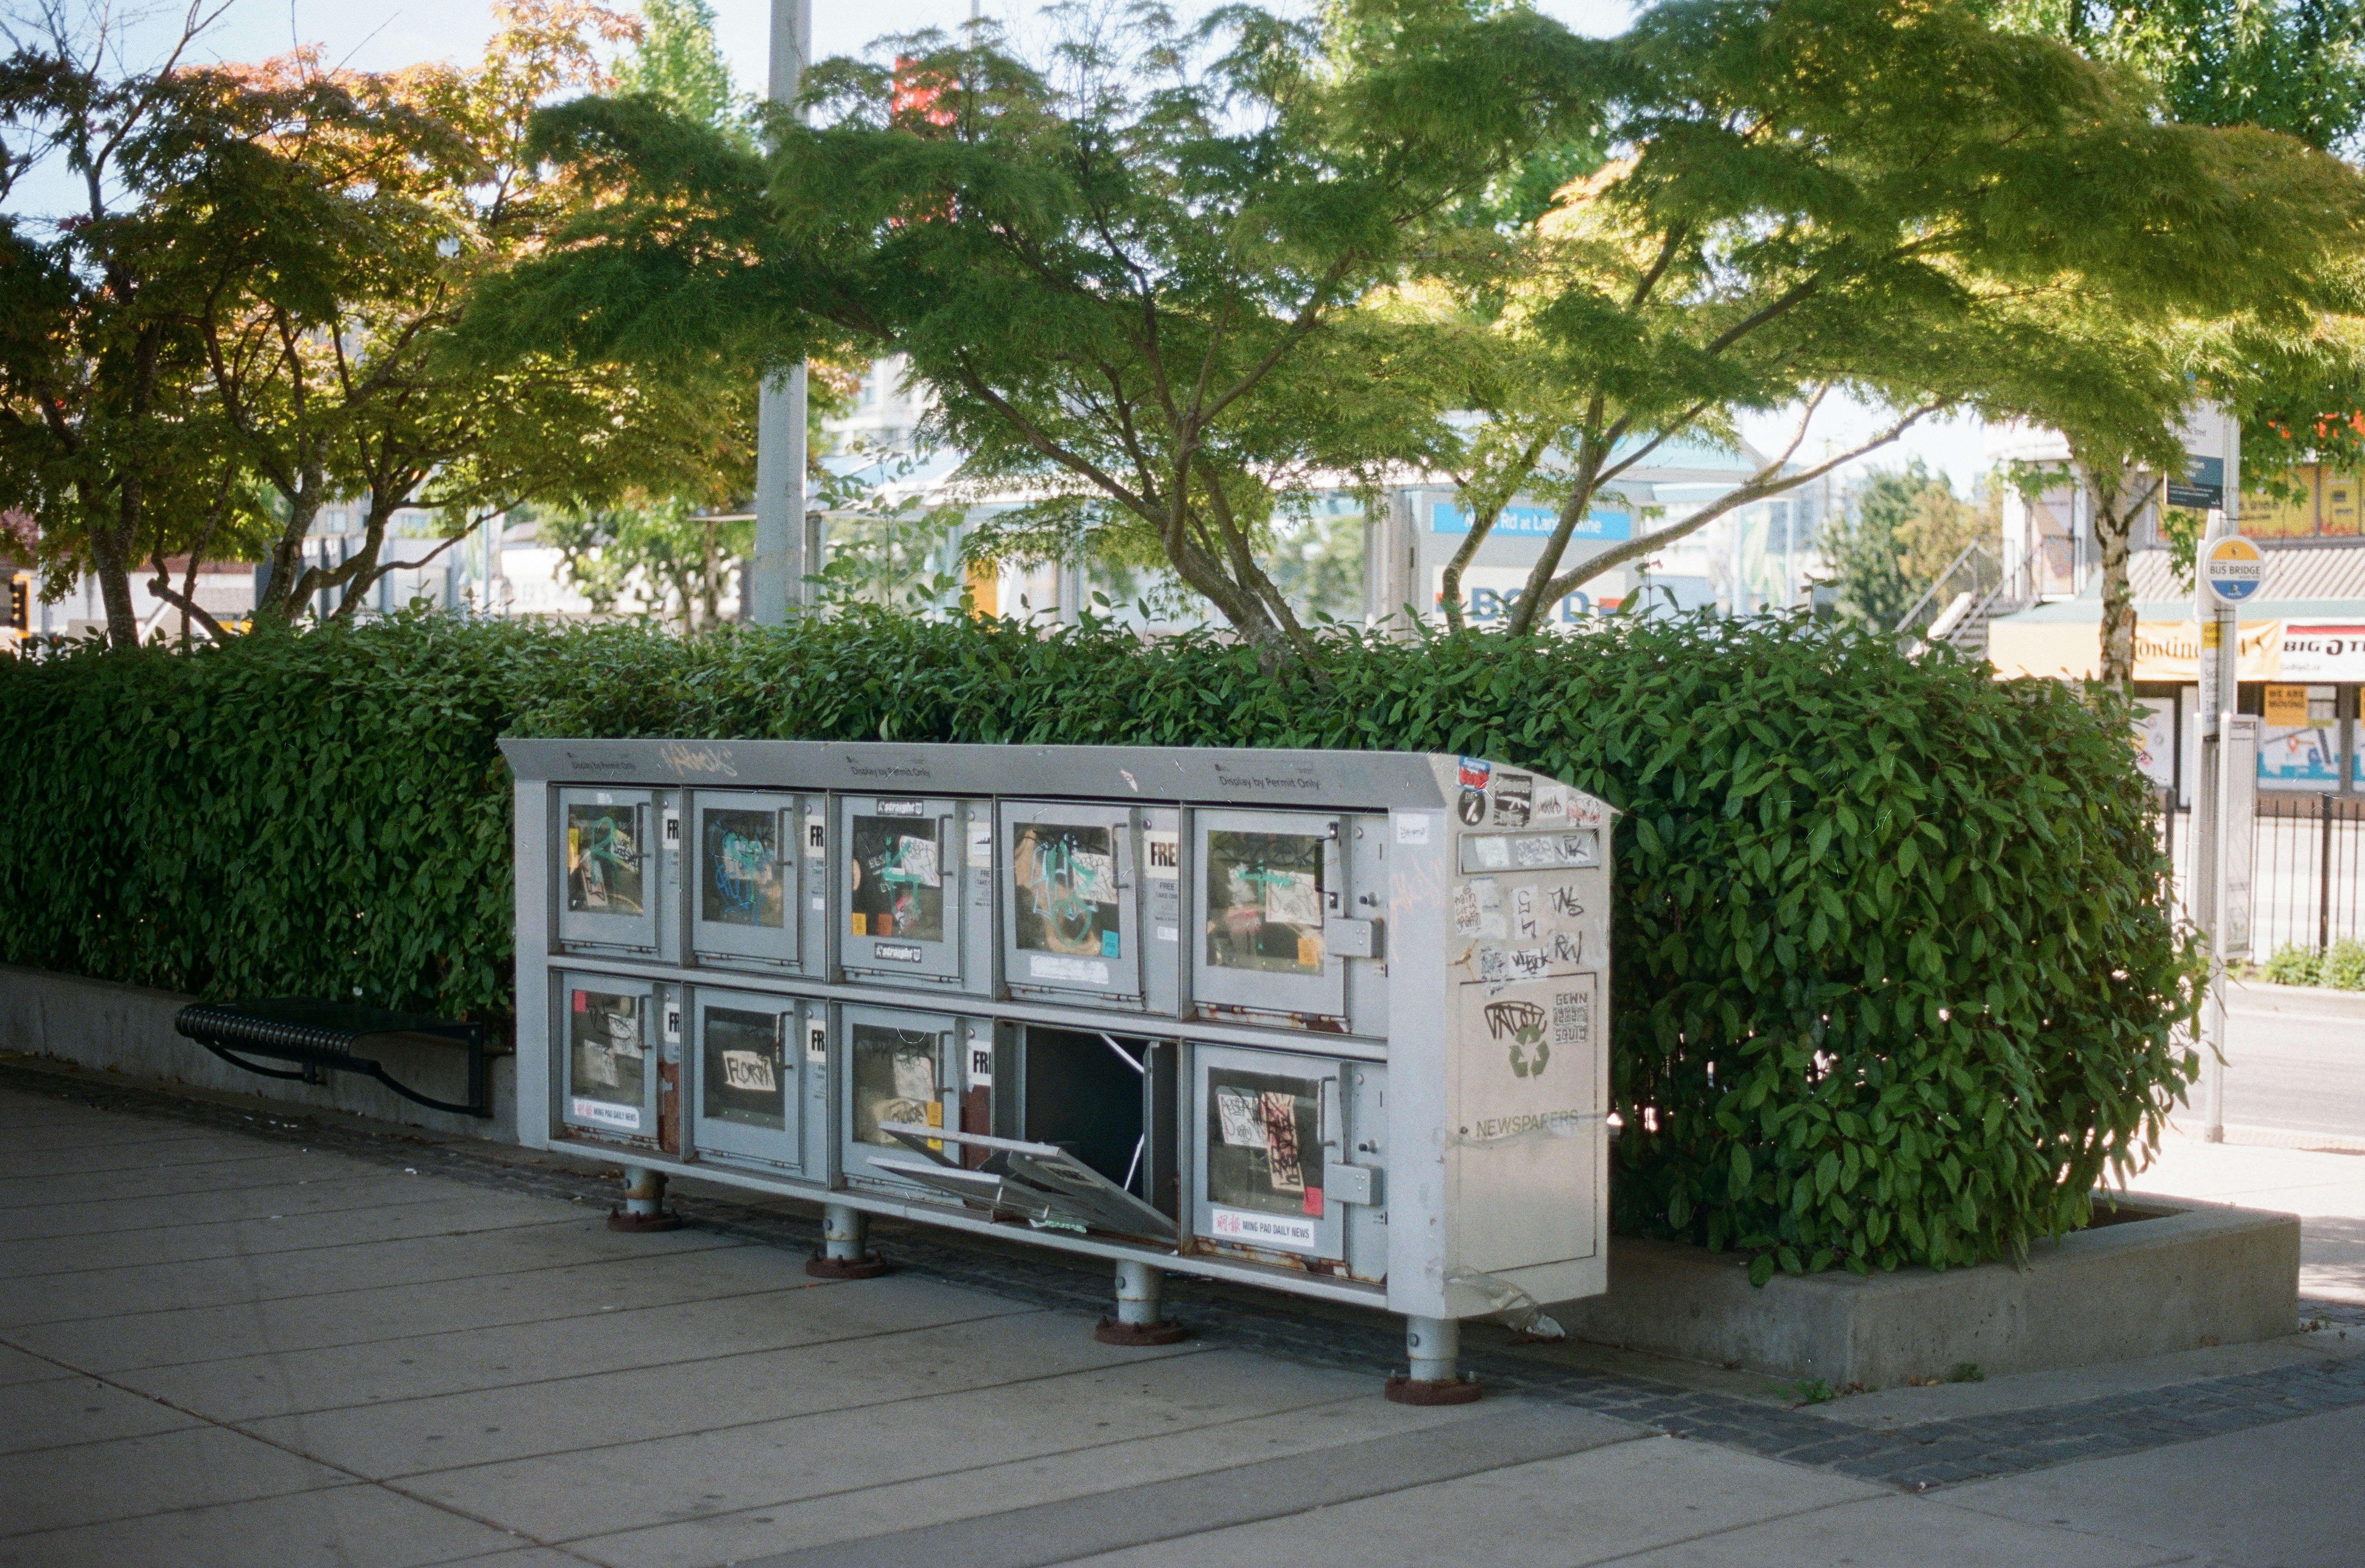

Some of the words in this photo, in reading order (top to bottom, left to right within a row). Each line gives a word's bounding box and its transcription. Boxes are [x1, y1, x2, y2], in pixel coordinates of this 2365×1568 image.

[1501, 512, 1517, 529] Rd
[1520, 517, 1530, 530] at
[2210, 566, 2227, 574] BUS
[2229, 566, 2260, 574] BRIDGE
[2284, 640, 2321, 652] BIG
[851, 767, 877, 777] Display
[878, 767, 887, 777] by
[888, 768, 912, 776] Permit
[913, 768, 930, 778] Only
[1219, 776, 1251, 788] Display
[1252, 776, 1264, 788] by
[1265, 777, 1296, 787] Permit
[1297, 778, 1319, 790] Only
[1159, 882, 1175, 891] FREE
[1476, 1109, 1579, 1137] NEWSPAPERS
[1217, 1214, 1240, 1233] 明報
[1242, 1221, 1258, 1232] MING
[1260, 1223, 1272, 1234] PAO
[1273, 1224, 1290, 1236] DAILY
[1292, 1227, 1310, 1239] NEWS
